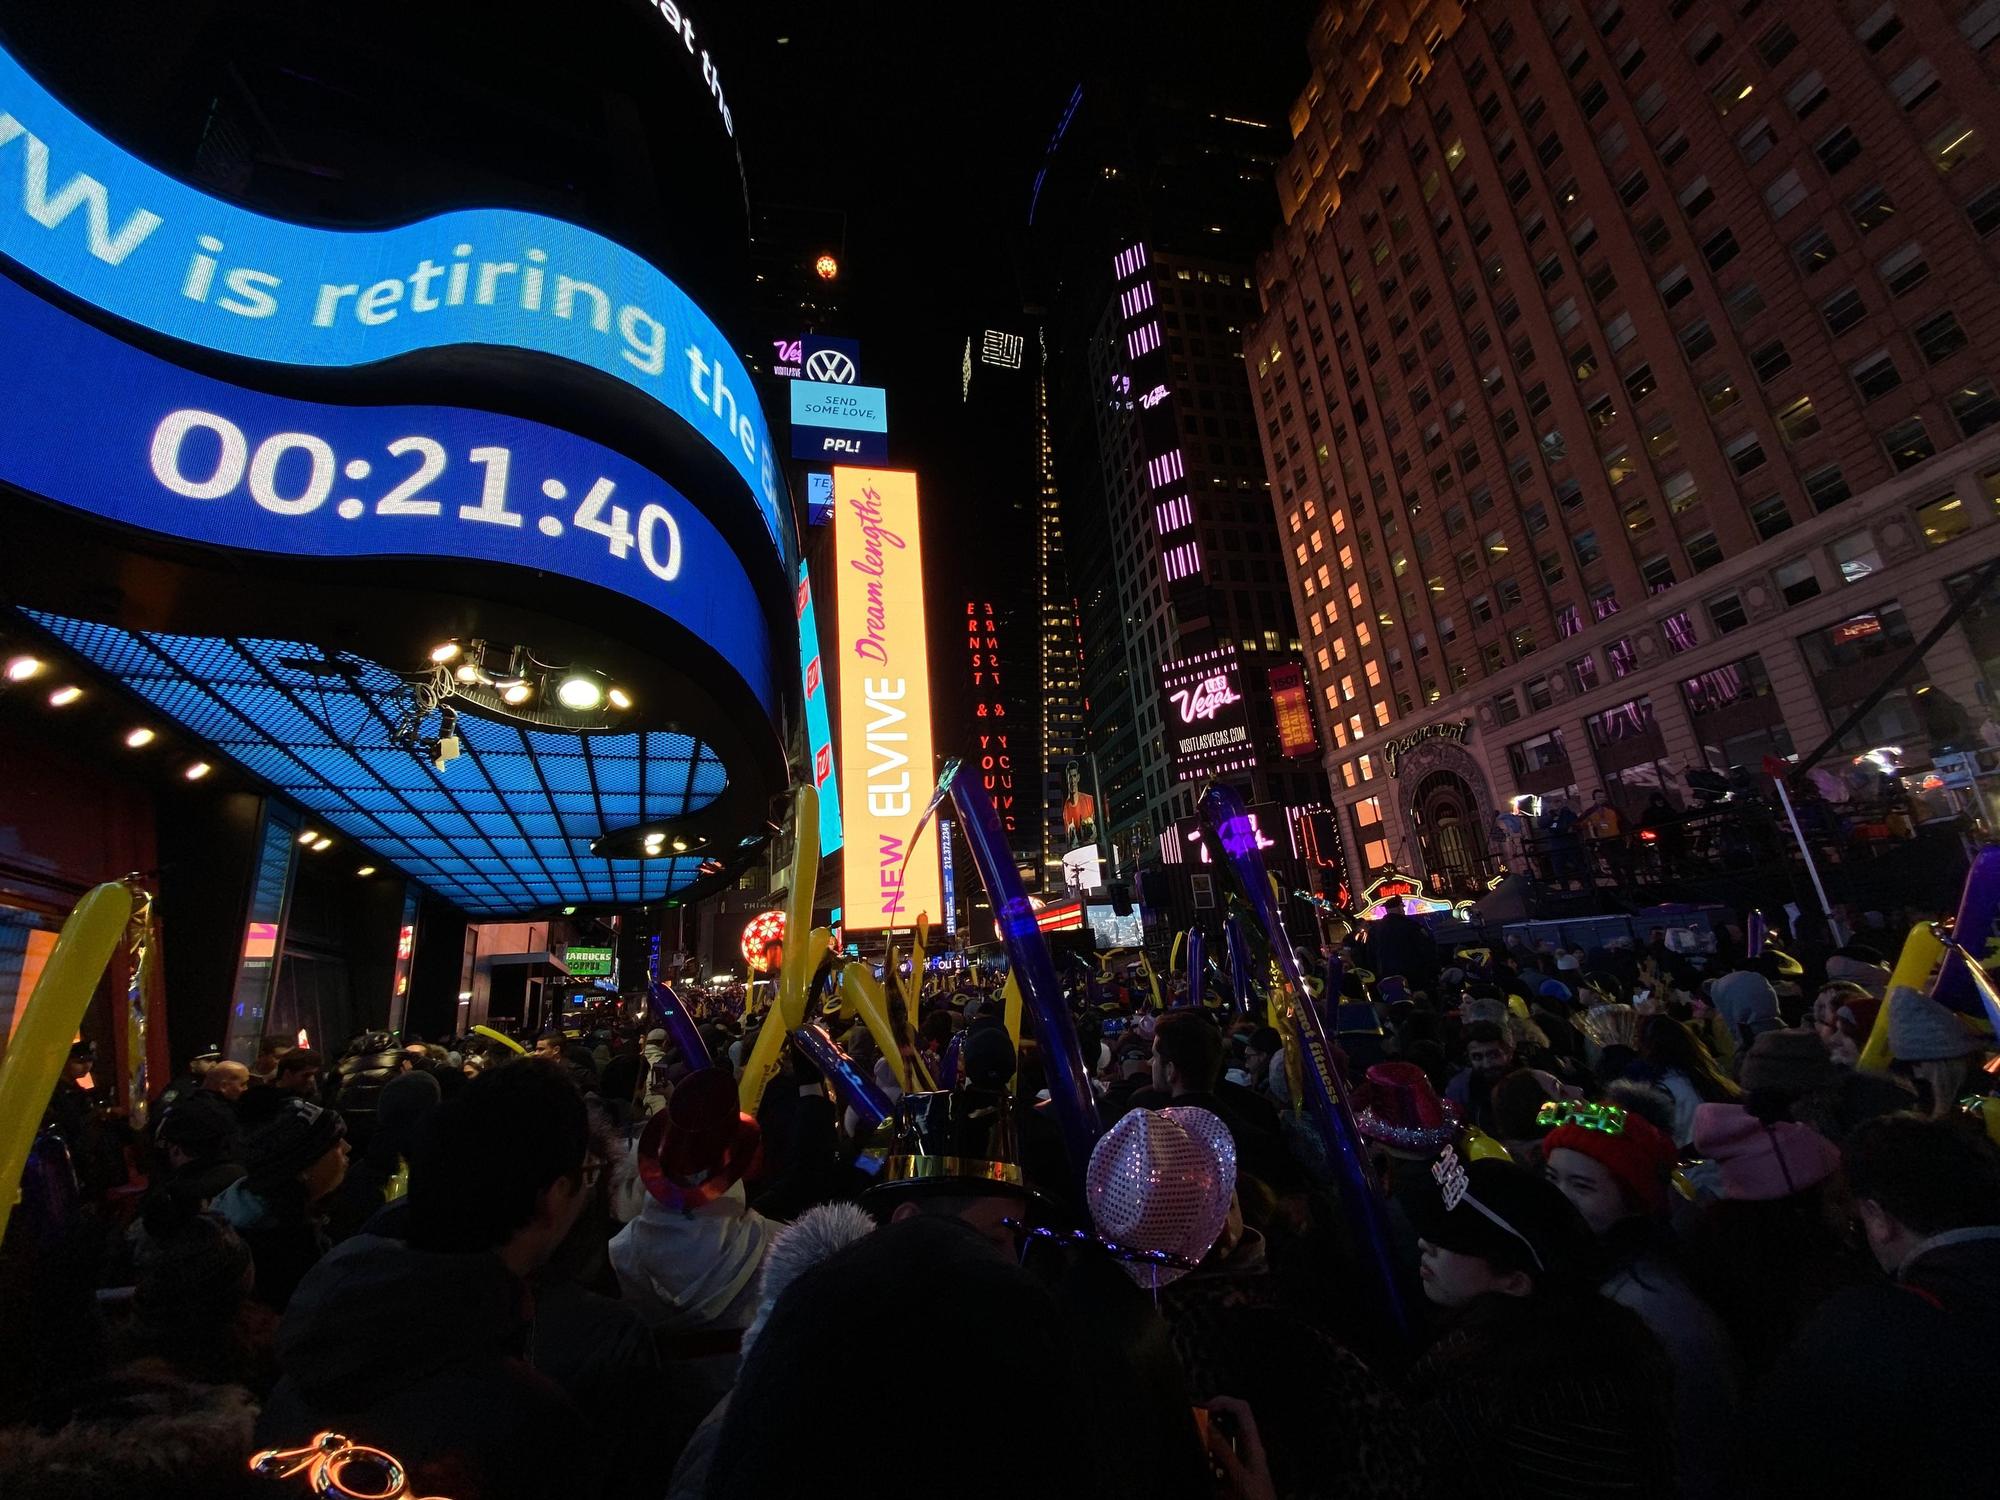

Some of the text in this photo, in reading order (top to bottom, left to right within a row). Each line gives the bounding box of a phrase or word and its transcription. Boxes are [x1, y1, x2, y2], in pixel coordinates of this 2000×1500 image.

[650, 0, 734, 138] at the
[0, 111, 757, 464] W is retiring the
[805, 404, 877, 420] SOME LOVE,
[825, 396, 857, 406] SEND
[823, 438, 861, 453] PPL!
[150, 408, 682, 582] 00:21:40
[813, 478, 834, 489] TE
[850, 486, 906, 578] lengths
[854, 580, 888, 667] Dream
[966, 602, 983, 685] ERNST
[977, 703, 988, 717] &
[1206, 678, 1226, 691] LAS
[1170, 682, 1241, 723] Vegas
[1276, 695, 1294, 748] FLAGSHIP
[1289, 708, 1302, 745] RETAIL
[865, 677, 910, 818] ELVIVE
[1179, 725, 1247, 754] VISITLASVEGAS.COM
[1384, 718, 1469, 779] Paramount
[879, 834, 906, 914] NEW
[941, 823, 952, 870] 212.372.2349
[565, 952, 612, 961] TARBUCKS
[1308, 1039, 1339, 1105] fitness
[1431, 1143, 1469, 1212] 2020
